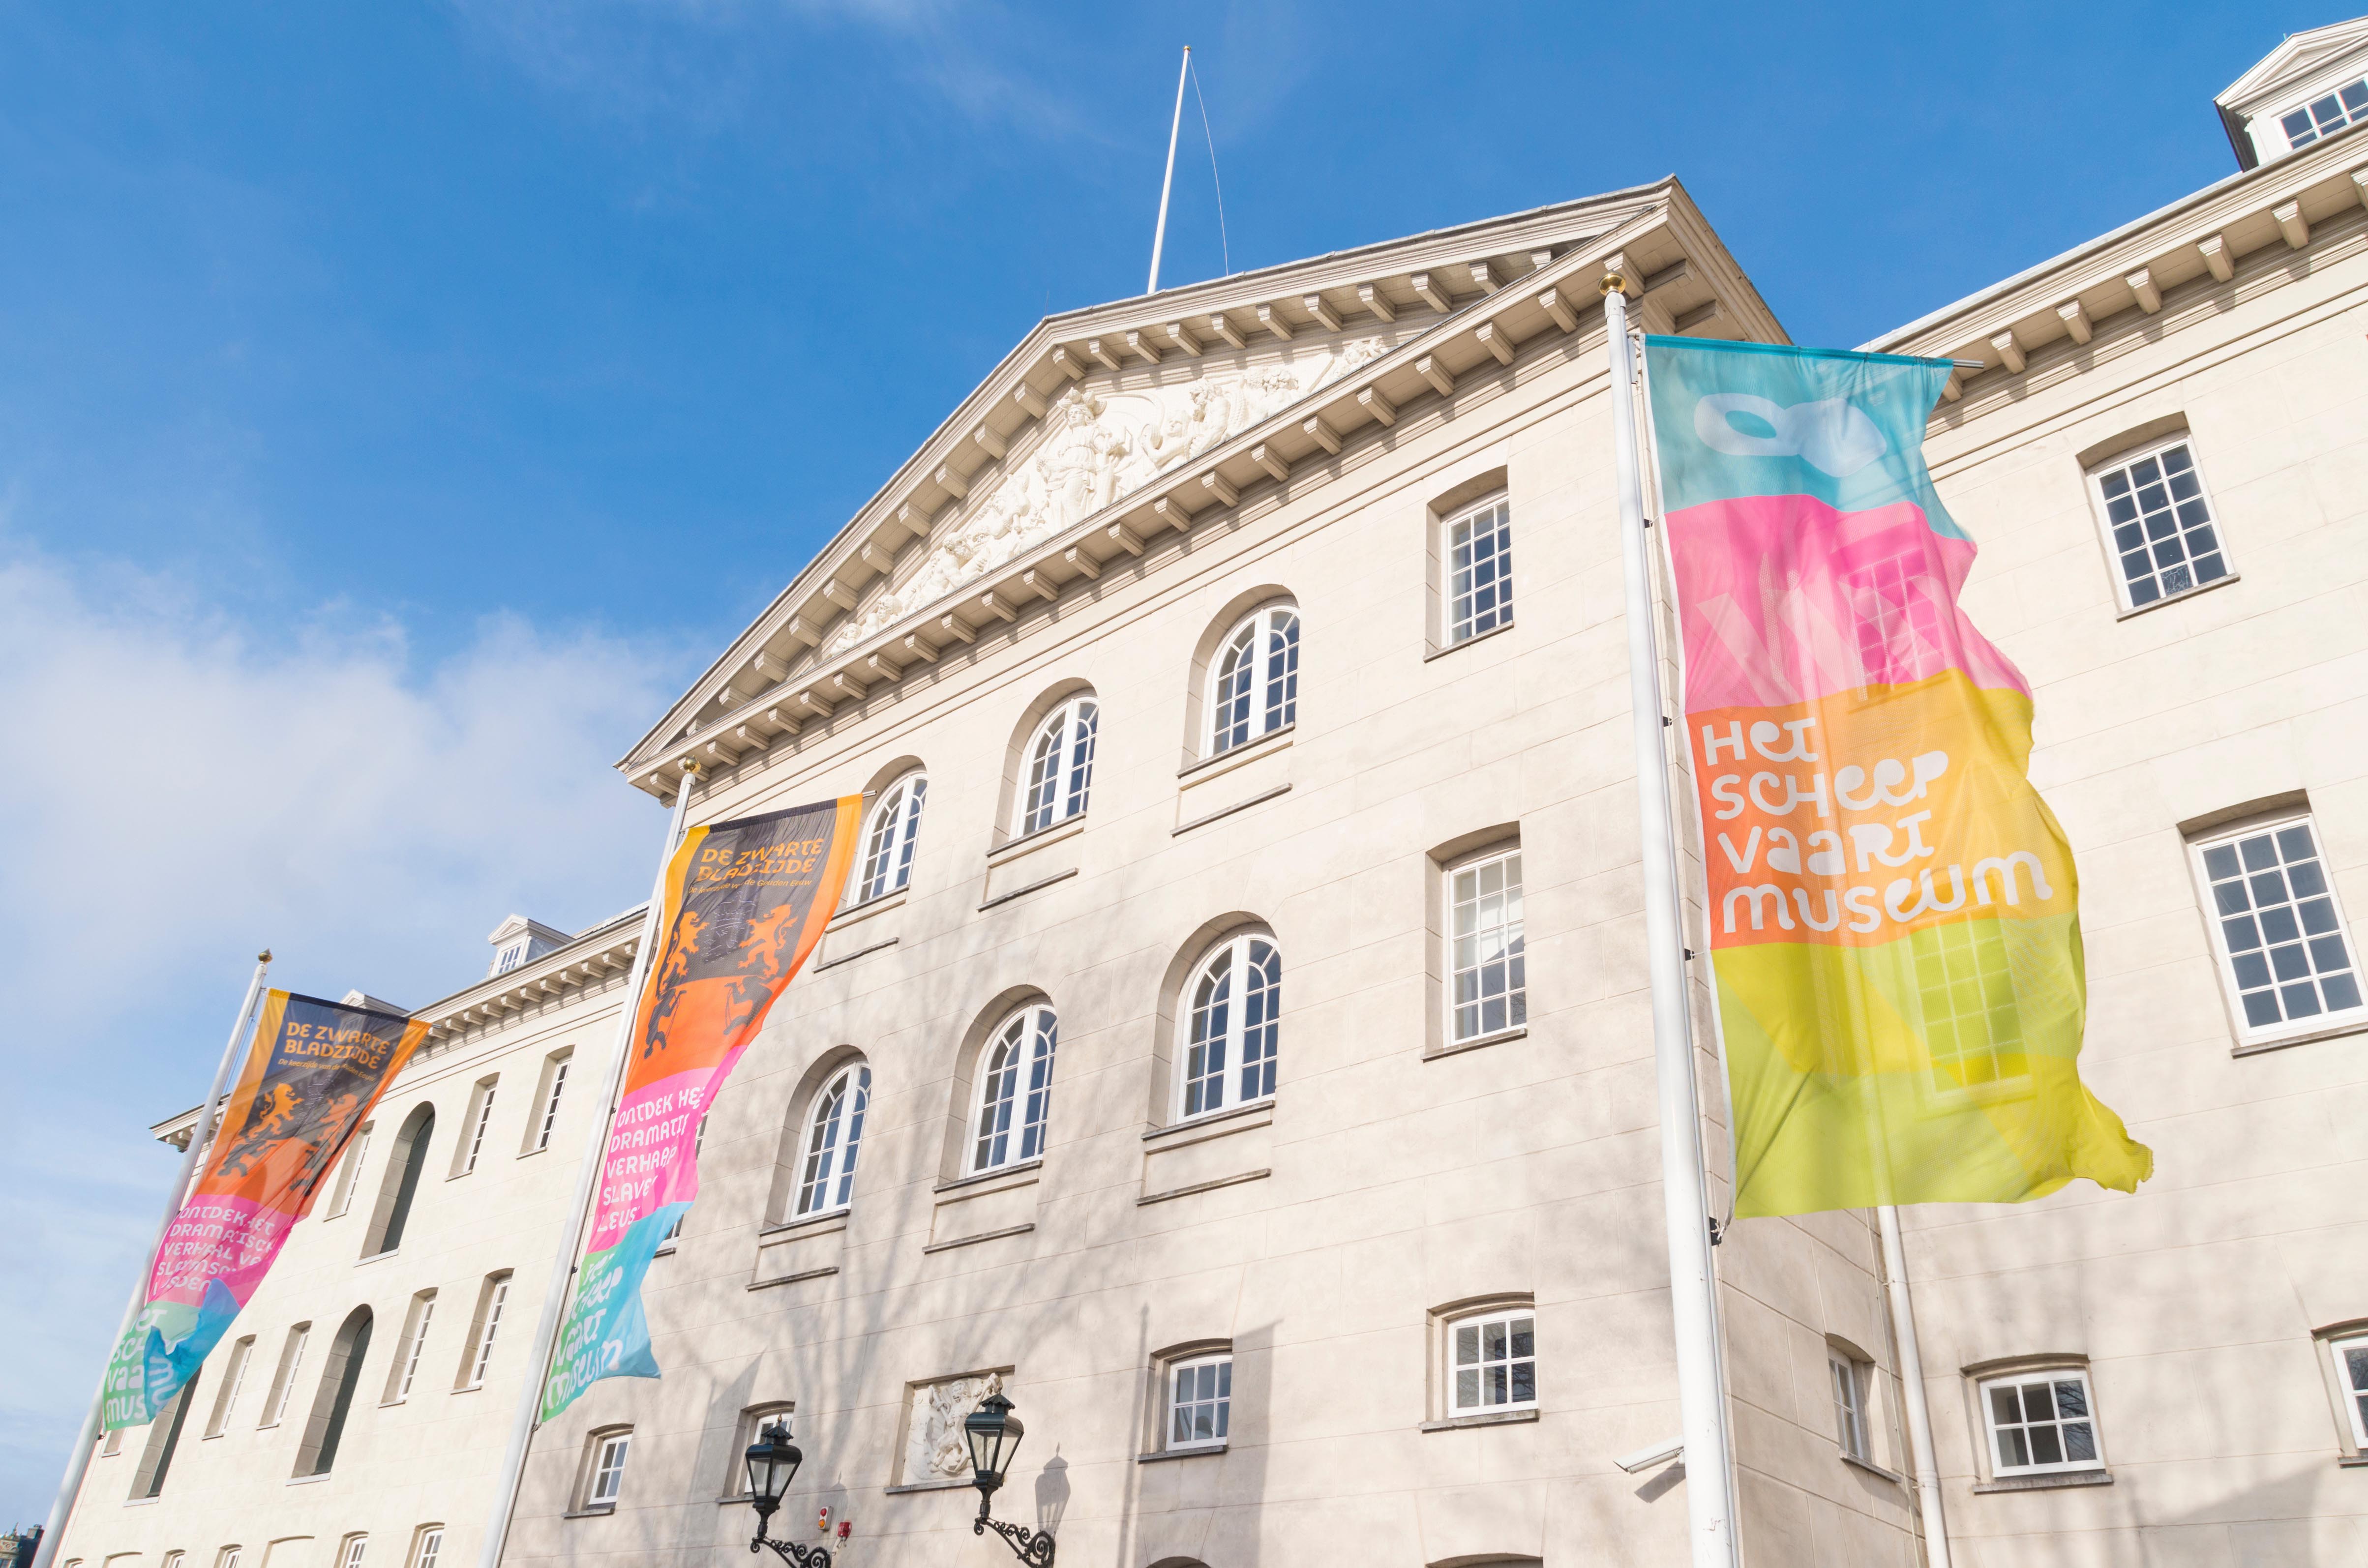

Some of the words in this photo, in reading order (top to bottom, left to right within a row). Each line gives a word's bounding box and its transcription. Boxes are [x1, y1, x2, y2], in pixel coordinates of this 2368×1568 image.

[700, 848, 734, 866] DE
[735, 838, 824, 865] ZWARTE
[286, 1022, 312, 1038] DE
[314, 1025, 390, 1054] ZWARTE
[284, 1039, 381, 1069] BLADZIJDE
[618, 1093, 673, 1128] ONTDEK
[179, 1206, 248, 1226] ONTDEK
